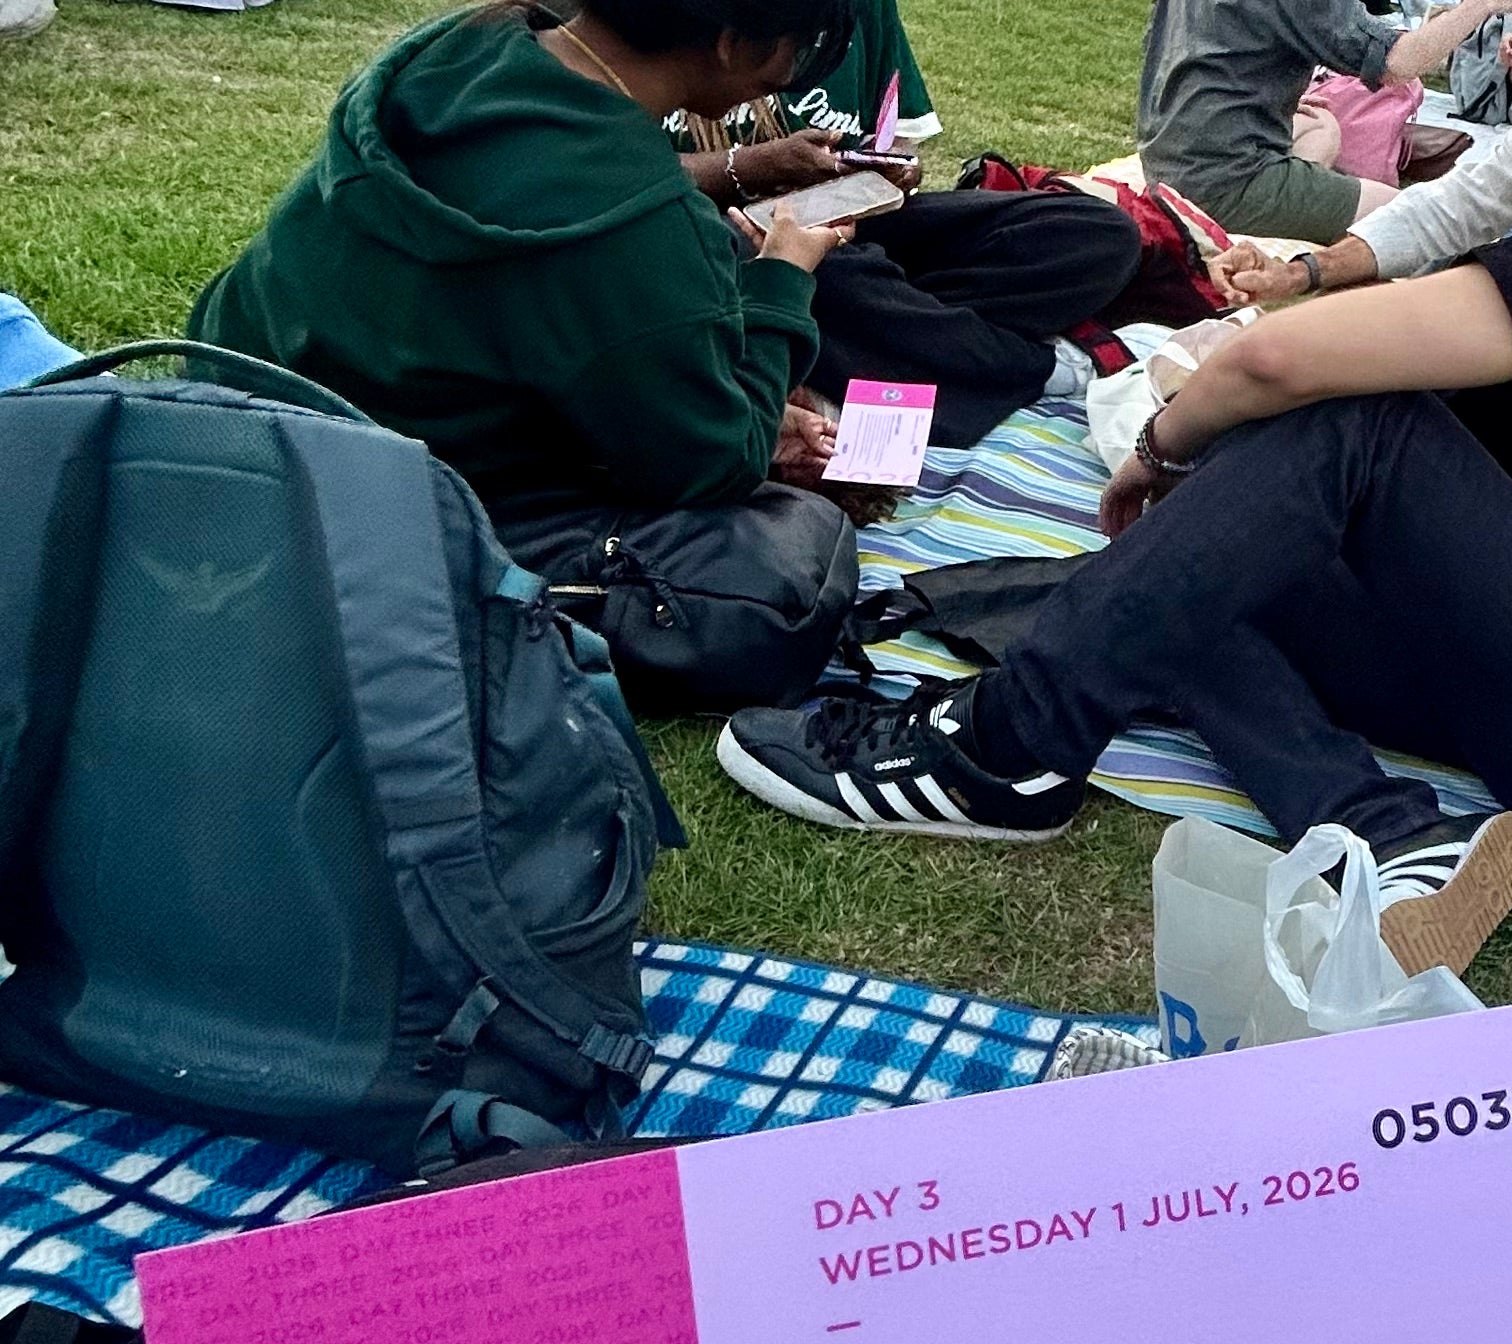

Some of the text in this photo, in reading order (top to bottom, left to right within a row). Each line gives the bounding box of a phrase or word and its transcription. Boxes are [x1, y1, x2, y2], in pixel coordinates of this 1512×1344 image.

[873, 756, 912, 772] adidas
[813, 1179, 941, 1231] DAY 3
[818, 1160, 1361, 1286] WEDNESDAY 1 JULY, 2026
